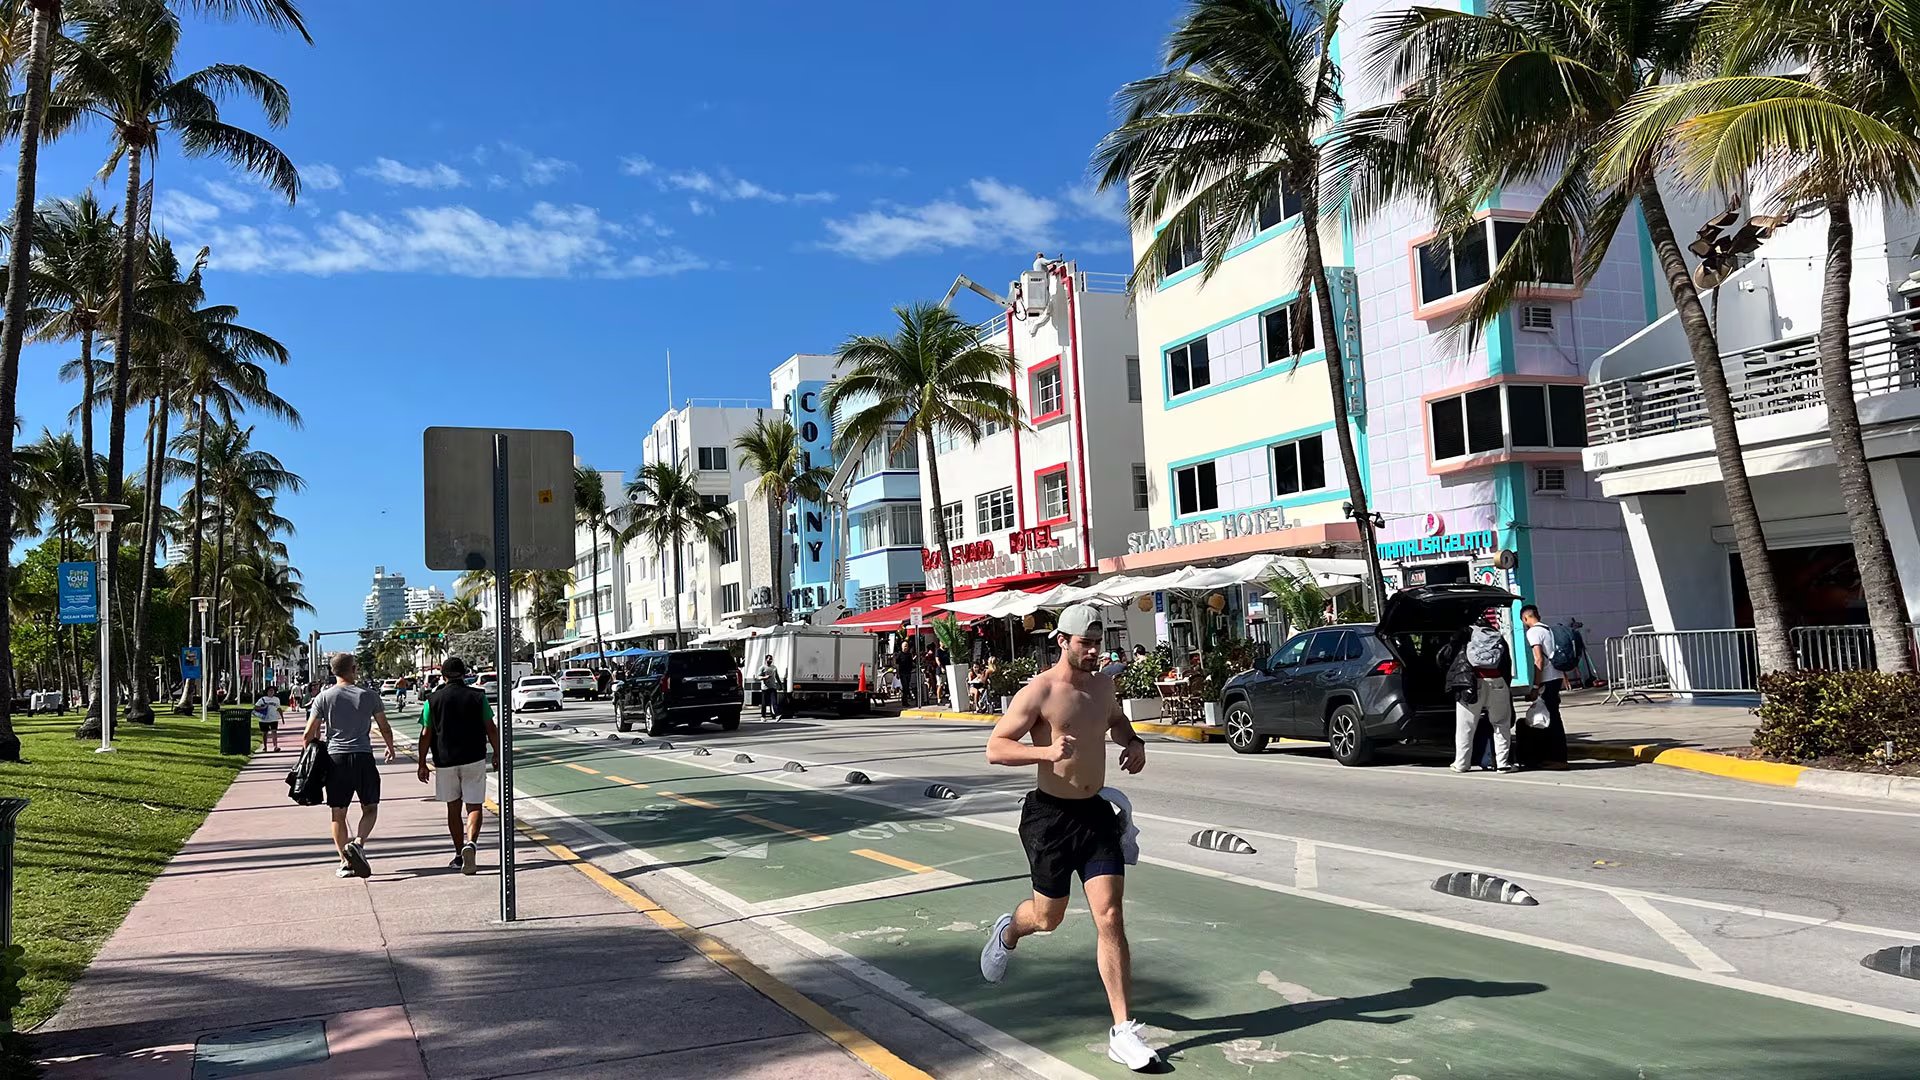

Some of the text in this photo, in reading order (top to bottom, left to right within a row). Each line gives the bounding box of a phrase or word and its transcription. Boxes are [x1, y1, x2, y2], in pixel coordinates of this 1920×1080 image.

[1341, 268, 1360, 413] STARLITE
[801, 391, 824, 562] COLNY
[1127, 505, 1293, 554] STARLITE HOTEL
[1442, 530, 1492, 551] GELATO
[921, 539, 994, 571] BOUEVARD
[1411, 572, 1424, 582] ATM
